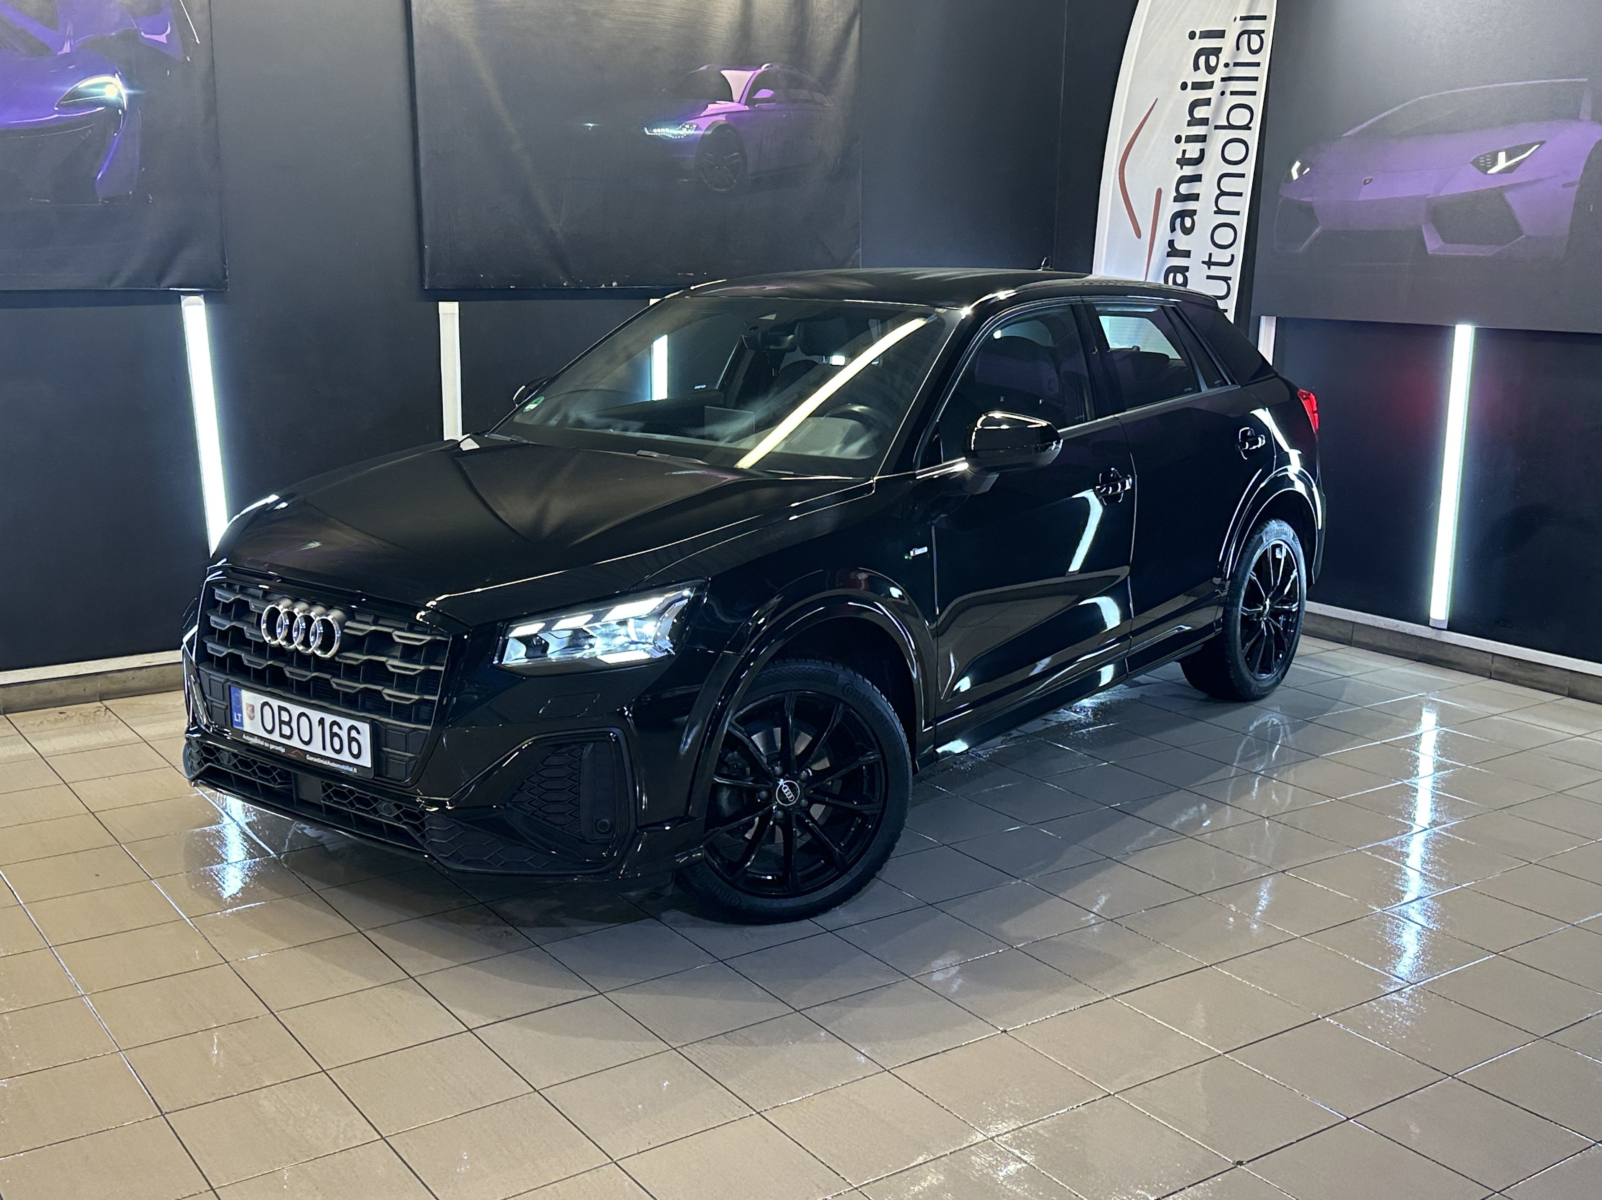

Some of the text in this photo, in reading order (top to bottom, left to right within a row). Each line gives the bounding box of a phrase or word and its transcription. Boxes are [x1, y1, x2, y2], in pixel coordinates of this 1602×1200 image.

[1163, 28, 1226, 288] arantiniai
[1201, 14, 1267, 312] utomobiliai
[234, 712, 242, 723] LT
